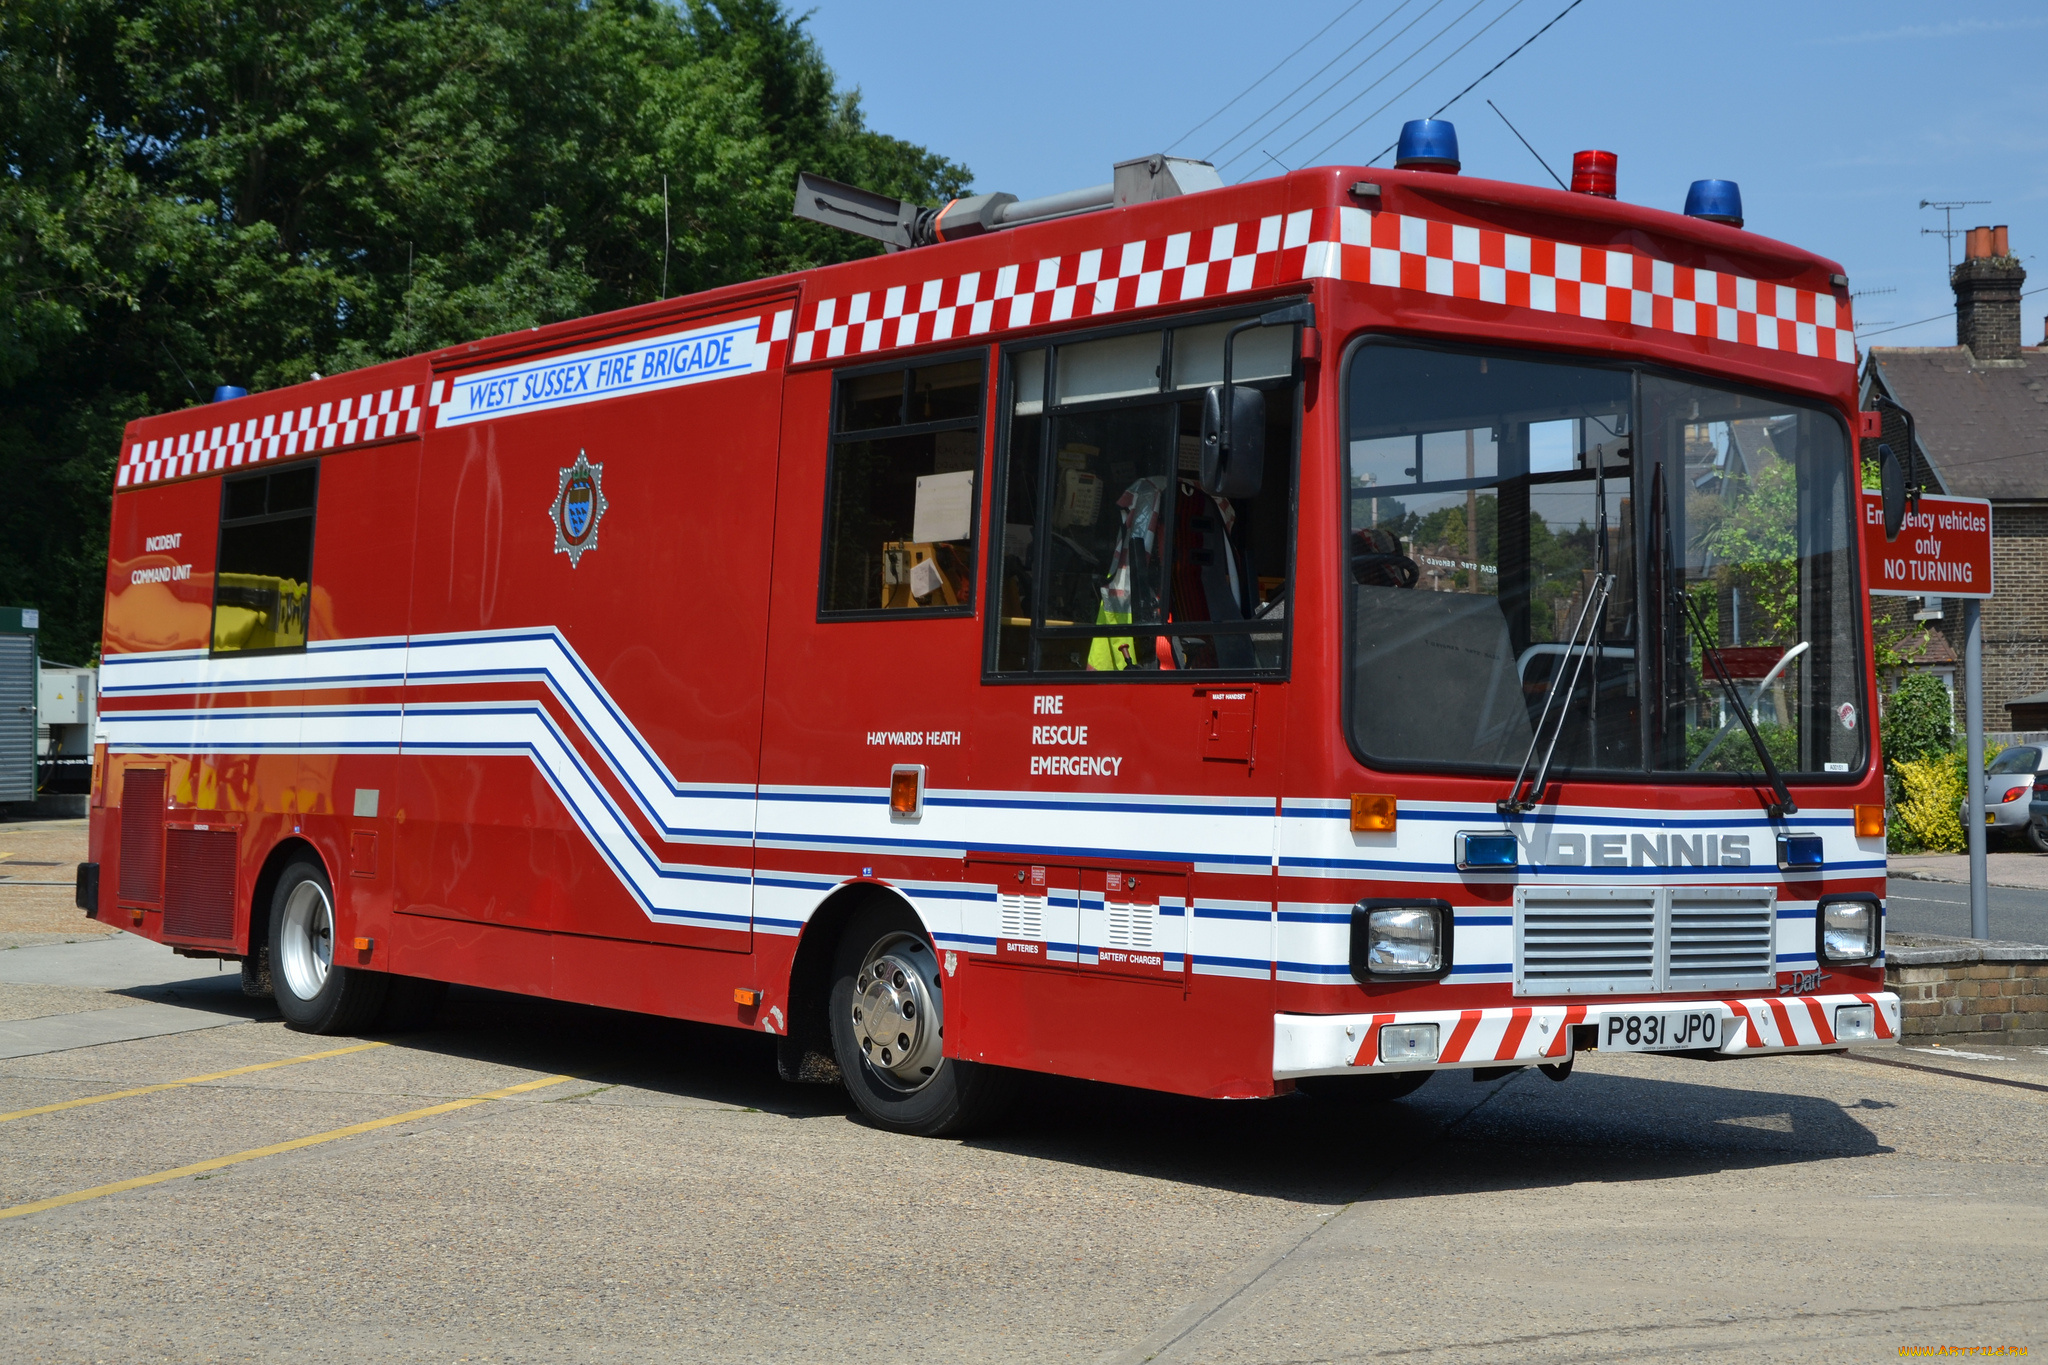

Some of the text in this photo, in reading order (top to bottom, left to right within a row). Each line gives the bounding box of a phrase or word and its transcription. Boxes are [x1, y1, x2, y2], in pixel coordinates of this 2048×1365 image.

[469, 336, 734, 410] WEST SUSSEX FIRE BRIGADE
[1866, 503, 1986, 533] Emgency vehicles
[145, 532, 182, 552] INCIDENT
[1915, 535, 1941, 559] only
[131, 564, 192, 585] COMMAND UNIT
[1884, 558, 1973, 583] NO TURNING
[1033, 695, 1063, 715] FIRE
[866, 731, 961, 746] HAYWARDS HEATH
[1032, 726, 1088, 745] RESCUE
[1030, 756, 1123, 776] EMERGENCY
[1545, 833, 1750, 867] DENNIS
[1006, 942, 1039, 954] BATTERIES
[1099, 951, 1161, 966] BATTERY CHARGER
[1792, 967, 1823, 994] Dart
[1608, 1016, 1666, 1046] P831
